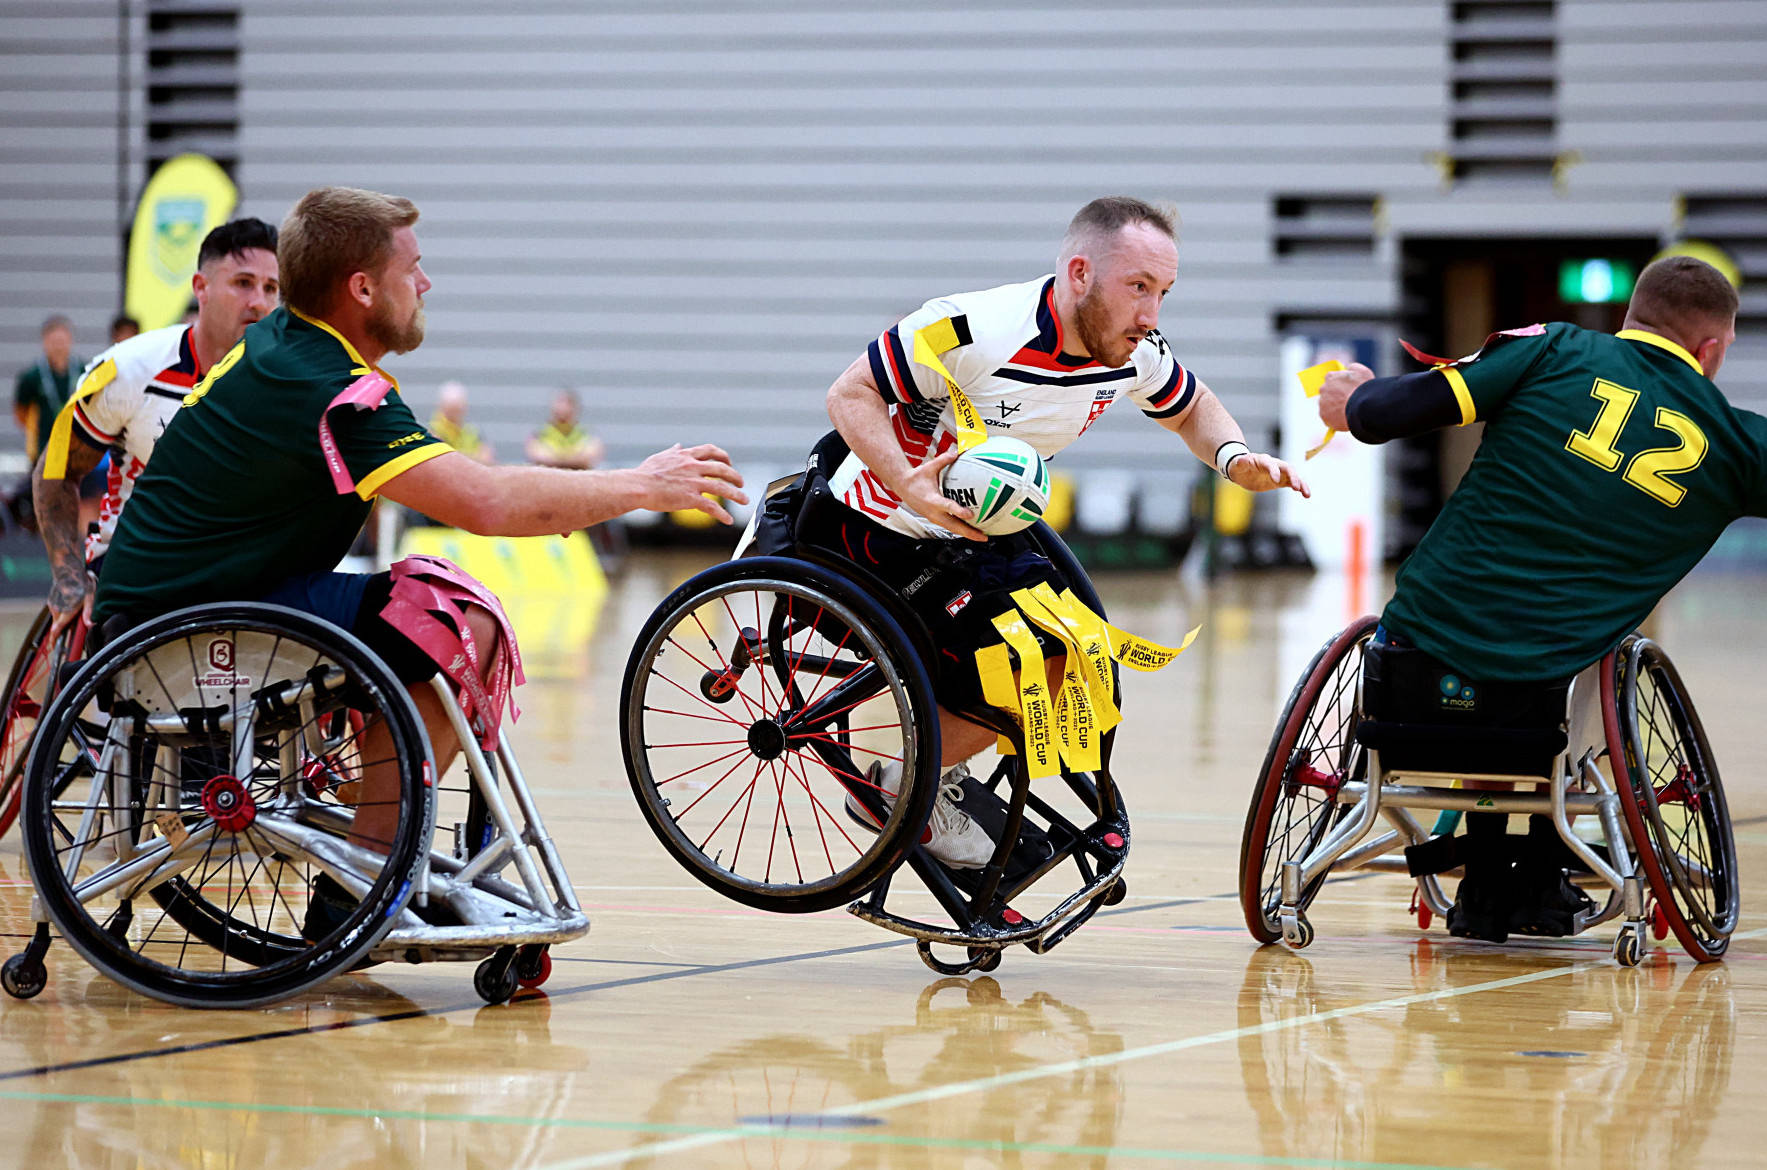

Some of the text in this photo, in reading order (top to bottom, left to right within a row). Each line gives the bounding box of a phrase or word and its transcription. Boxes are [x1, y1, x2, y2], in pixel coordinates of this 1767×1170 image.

[963, 408, 975, 429] CUP
[1564, 377, 1709, 508] 12
[1130, 648, 1166, 665] WORLD
[195, 678, 250, 688] WHEELCHAIR
[1449, 699, 1475, 709] mogo
[1071, 686, 1088, 749] WORLD CUP
[1031, 699, 1047, 766] WORLD CUP
[1060, 725, 1070, 747] CUP
